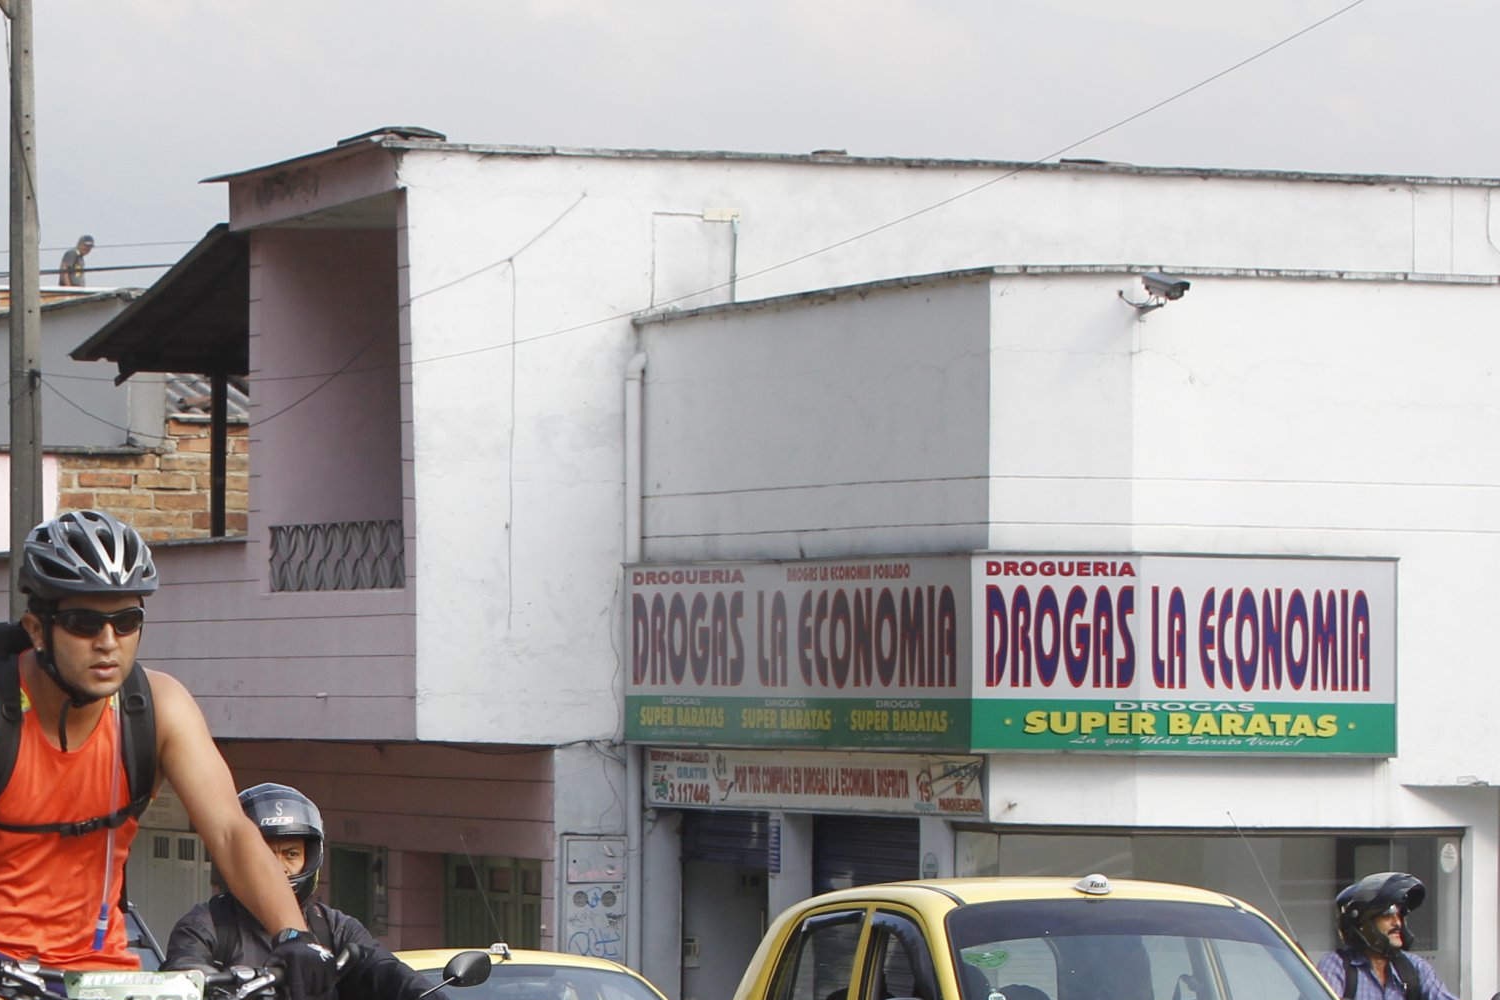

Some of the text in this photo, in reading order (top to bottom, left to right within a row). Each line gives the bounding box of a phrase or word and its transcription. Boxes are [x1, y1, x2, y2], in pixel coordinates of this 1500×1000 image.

[985, 561, 1137, 577] DROGUERIA
[632, 570, 745, 586] DROGUERIA
[632, 585, 958, 690] DROGAS LA ECONOMIA
[985, 584, 1370, 692] DROGAS LA ECONOMIA
[662, 697, 701, 706] DROGAS
[764, 699, 807, 708] DROGAS
[875, 700, 921, 709] DROGAS
[1114, 701, 1256, 713] DROGAS
[639, 706, 725, 729] SUPER BARATAS
[741, 709, 833, 731] SUPER BARATAS
[849, 711, 949, 732] SUPER BARATAS
[1023, 711, 1339, 738] SUPER BARATAS
[1069, 735, 1099, 744] La
[1104, 737, 1139, 746] que
[1184, 736, 1242, 747] Barato
[677, 767, 708, 780] GRATIS
[734, 766, 747, 793] POR
[762, 766, 793, 795] COMPRAS
[83, 974, 162, 986] KEYMAKER
